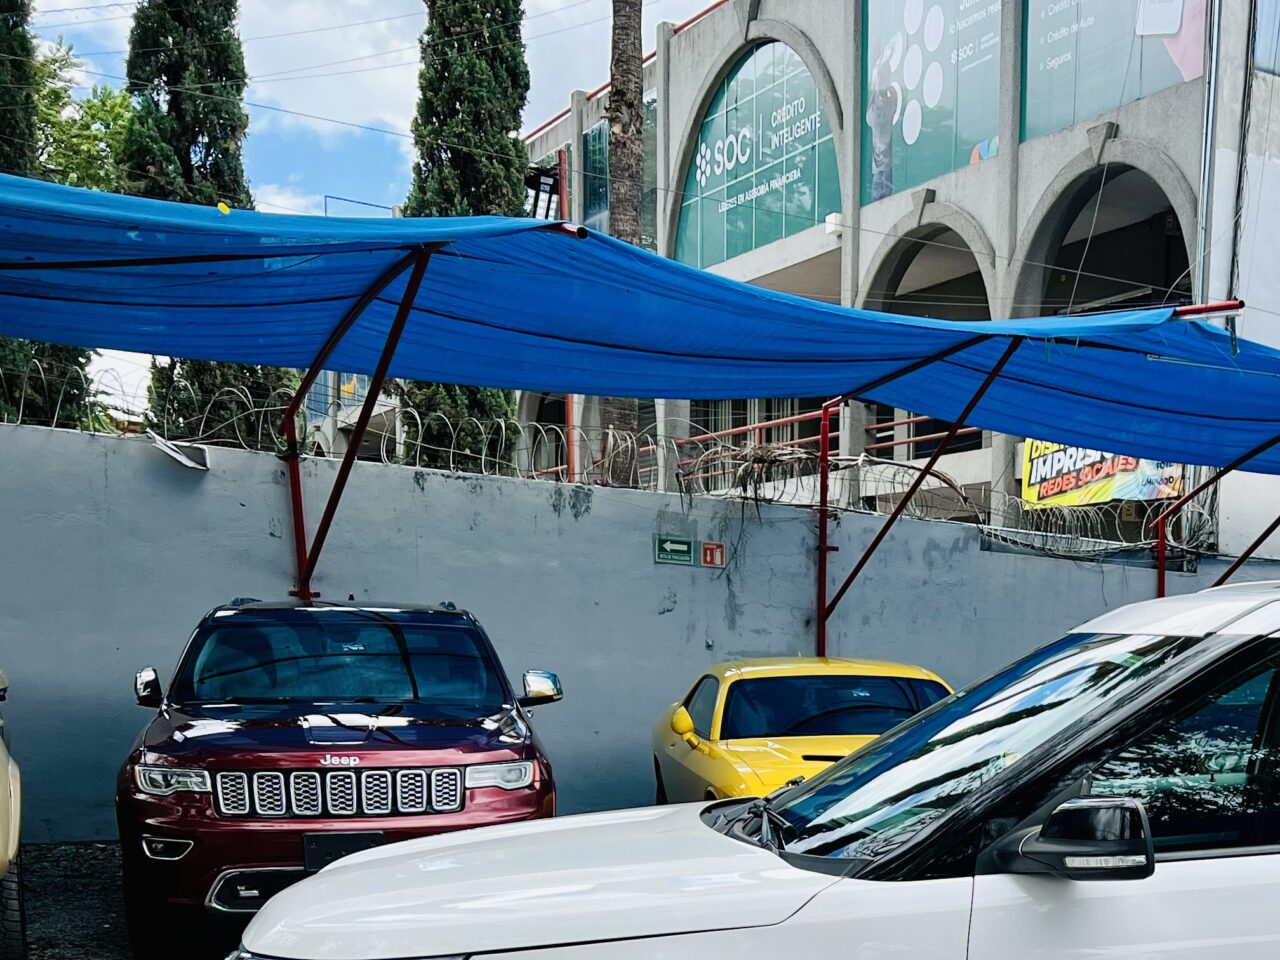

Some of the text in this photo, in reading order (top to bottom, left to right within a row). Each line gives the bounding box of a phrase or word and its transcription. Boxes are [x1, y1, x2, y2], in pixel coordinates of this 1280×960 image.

[1046, 51, 1072, 70] Seguros
[771, 111, 821, 150] INTELIGENTE
[713, 127, 750, 175] SOC
[770, 167, 801, 191] FINANCIERA
[1040, 456, 1136, 498] REDES SOCIALES
[320, 754, 360, 766] Jeep
